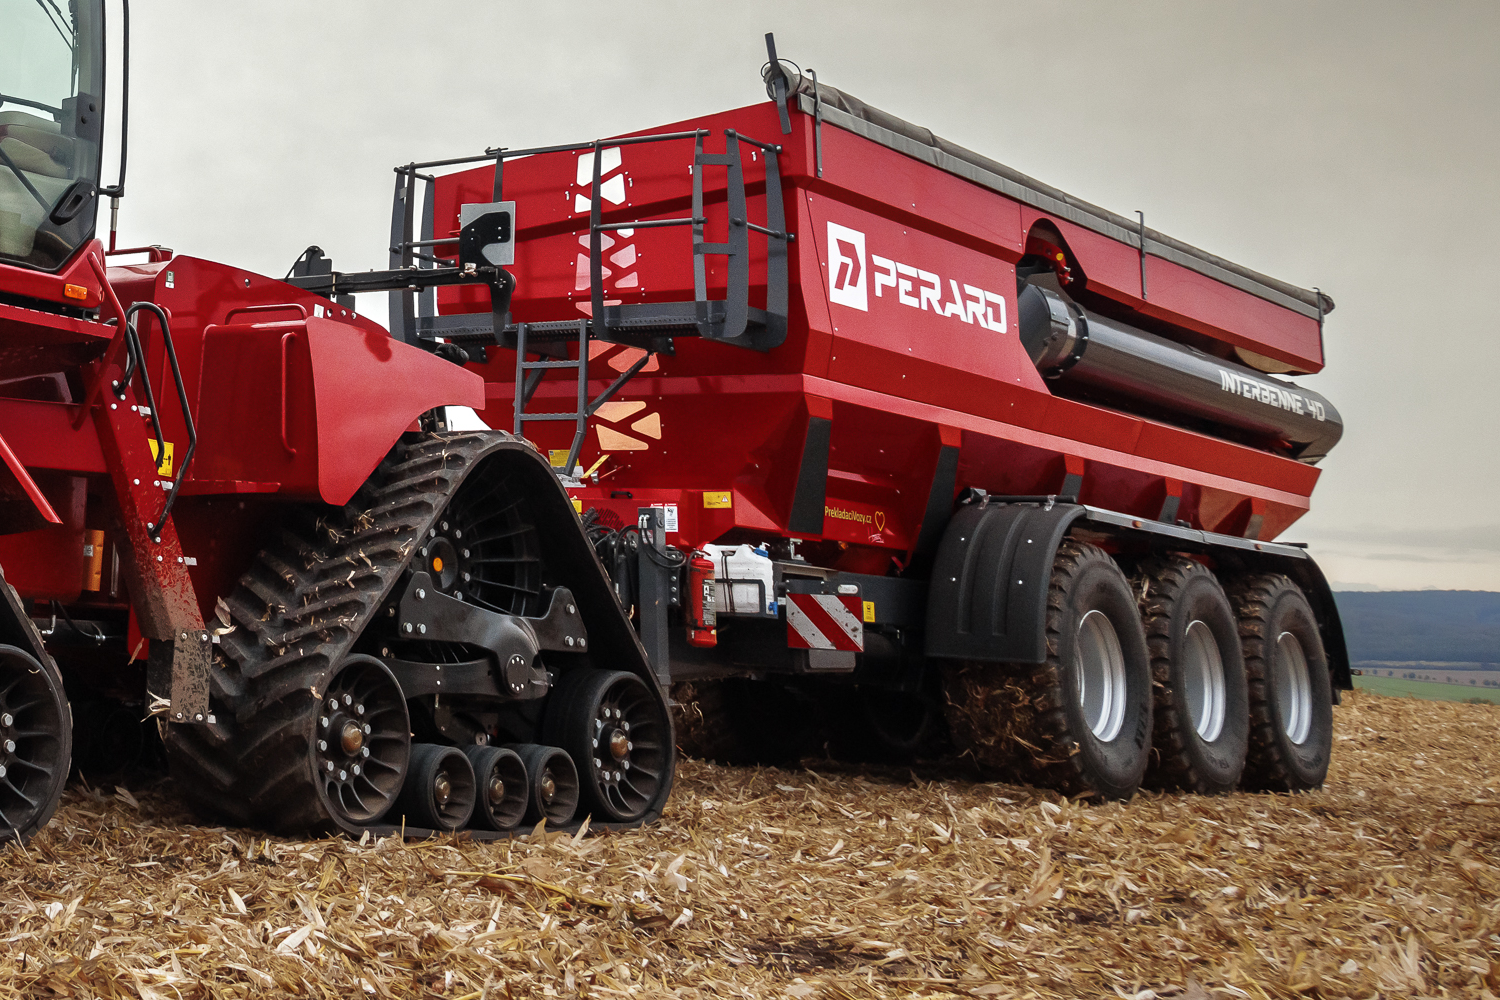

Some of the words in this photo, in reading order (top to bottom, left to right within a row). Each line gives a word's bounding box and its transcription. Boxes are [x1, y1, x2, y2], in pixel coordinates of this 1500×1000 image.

[871, 254, 1007, 334] PERARD
[1219, 369, 1304, 415] INTERBENNE
[1304, 398, 1325, 421] 40
